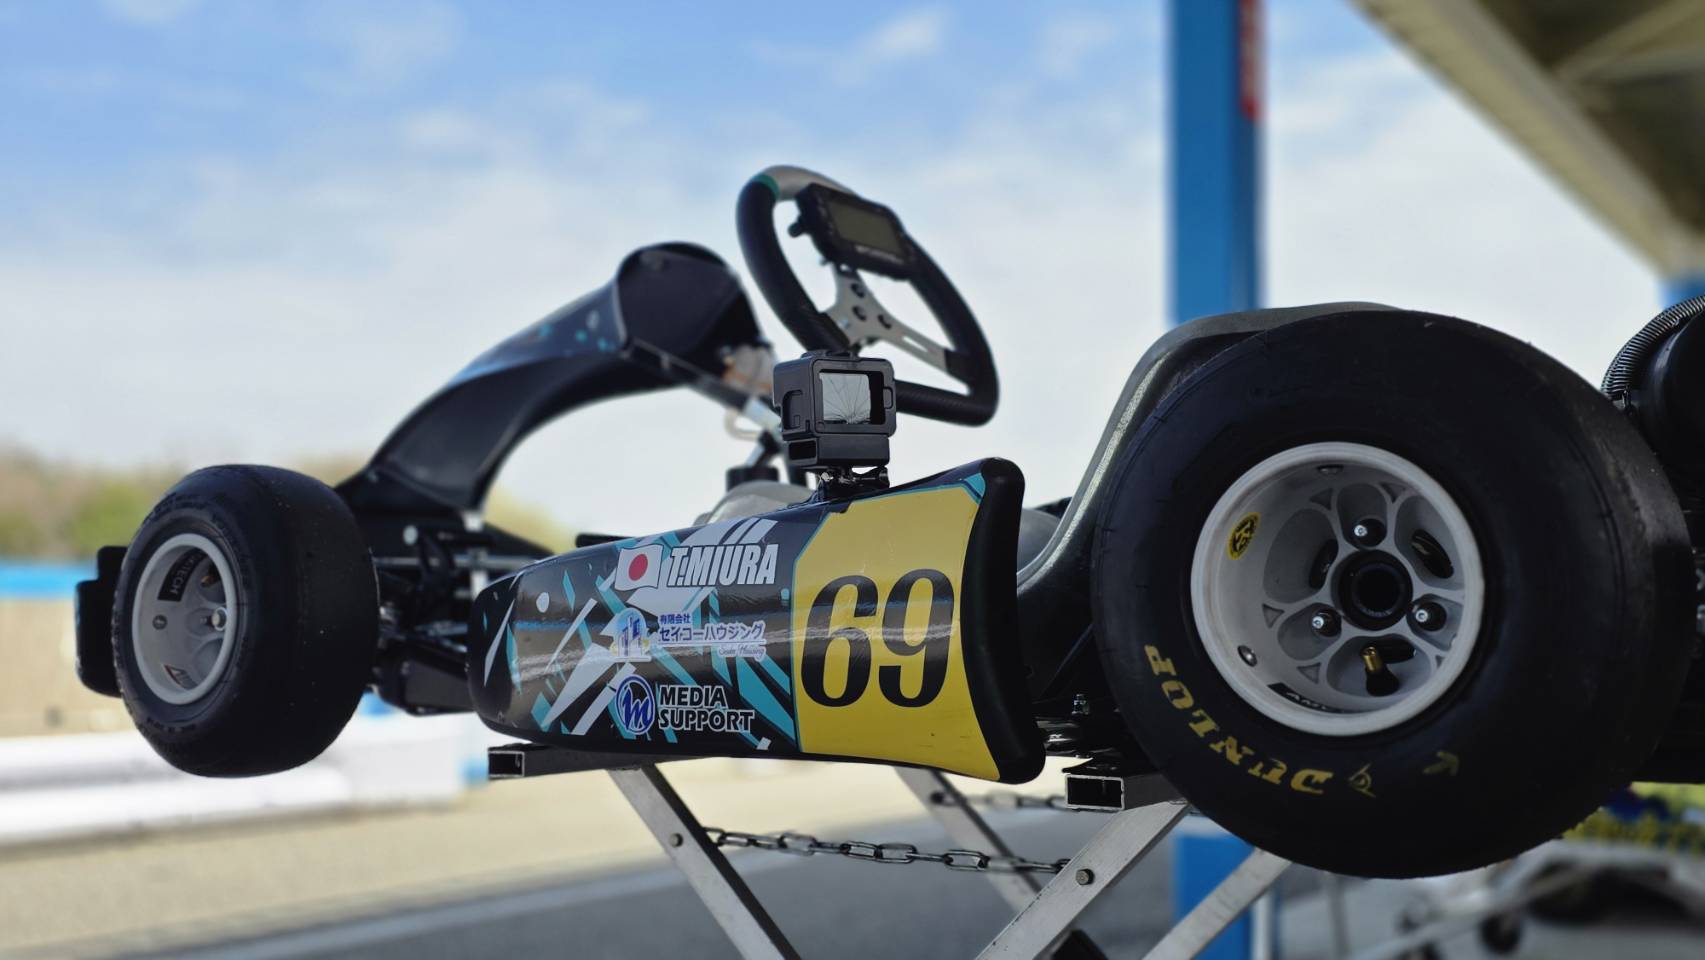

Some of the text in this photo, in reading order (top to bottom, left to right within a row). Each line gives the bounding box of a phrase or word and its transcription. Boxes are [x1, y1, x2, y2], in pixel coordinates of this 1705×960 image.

[667, 543, 778, 586] T.MIURA
[660, 613, 690, 624] 有限会社
[659, 623, 763, 642] セイコーハウジング
[801, 568, 955, 708] 69
[659, 685, 728, 708] MEDIA
[659, 709, 755, 733] SUPPORT
[1144, 644, 1334, 794] DUNLOP
